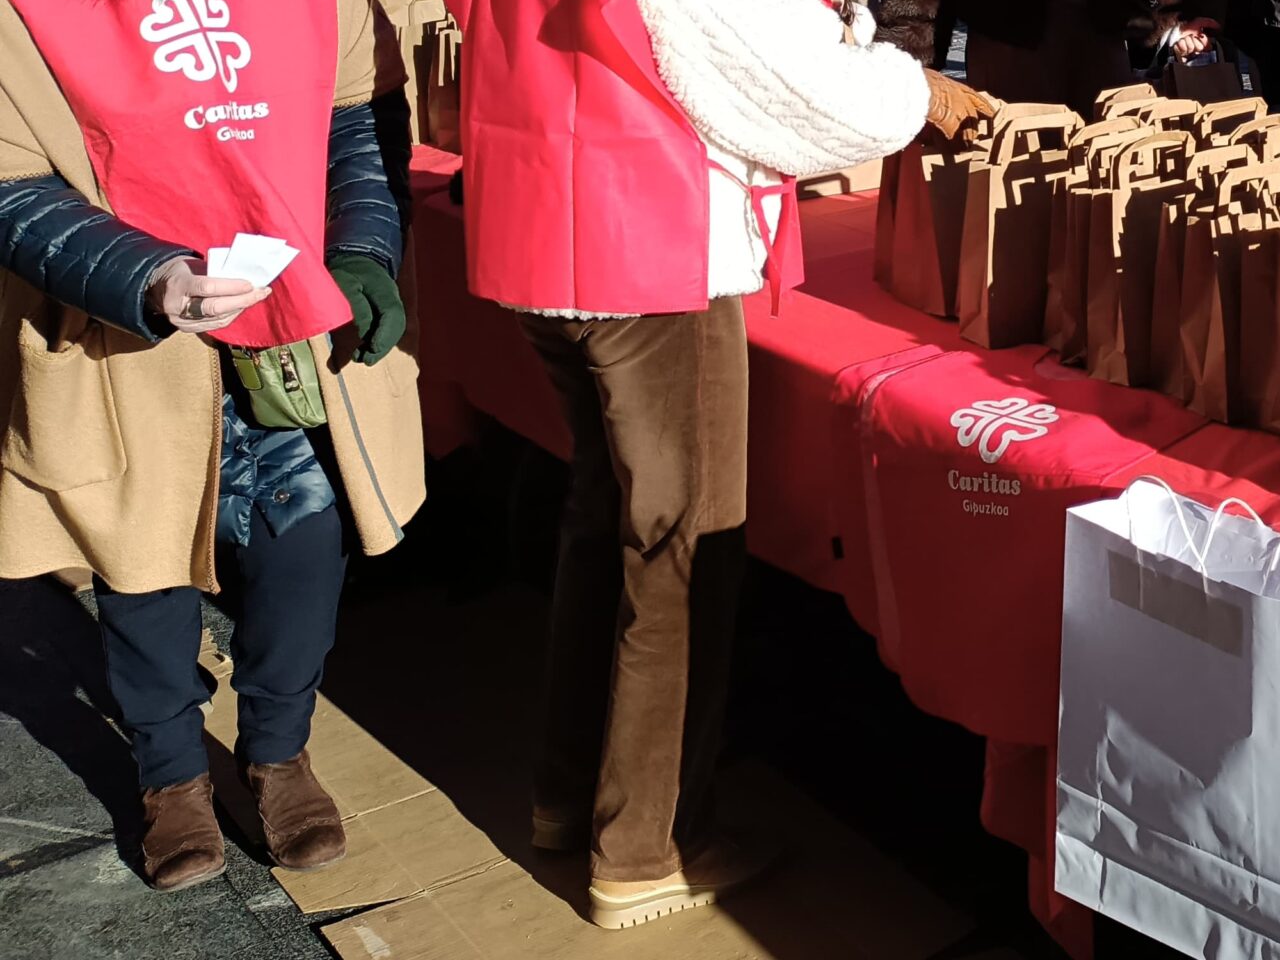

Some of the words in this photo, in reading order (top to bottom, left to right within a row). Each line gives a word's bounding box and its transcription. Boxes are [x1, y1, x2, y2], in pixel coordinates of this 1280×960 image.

[184, 101, 269, 129] Caritas
[948, 470, 1021, 495] Caritas
[963, 500, 1009, 517] Gipuzkoa
